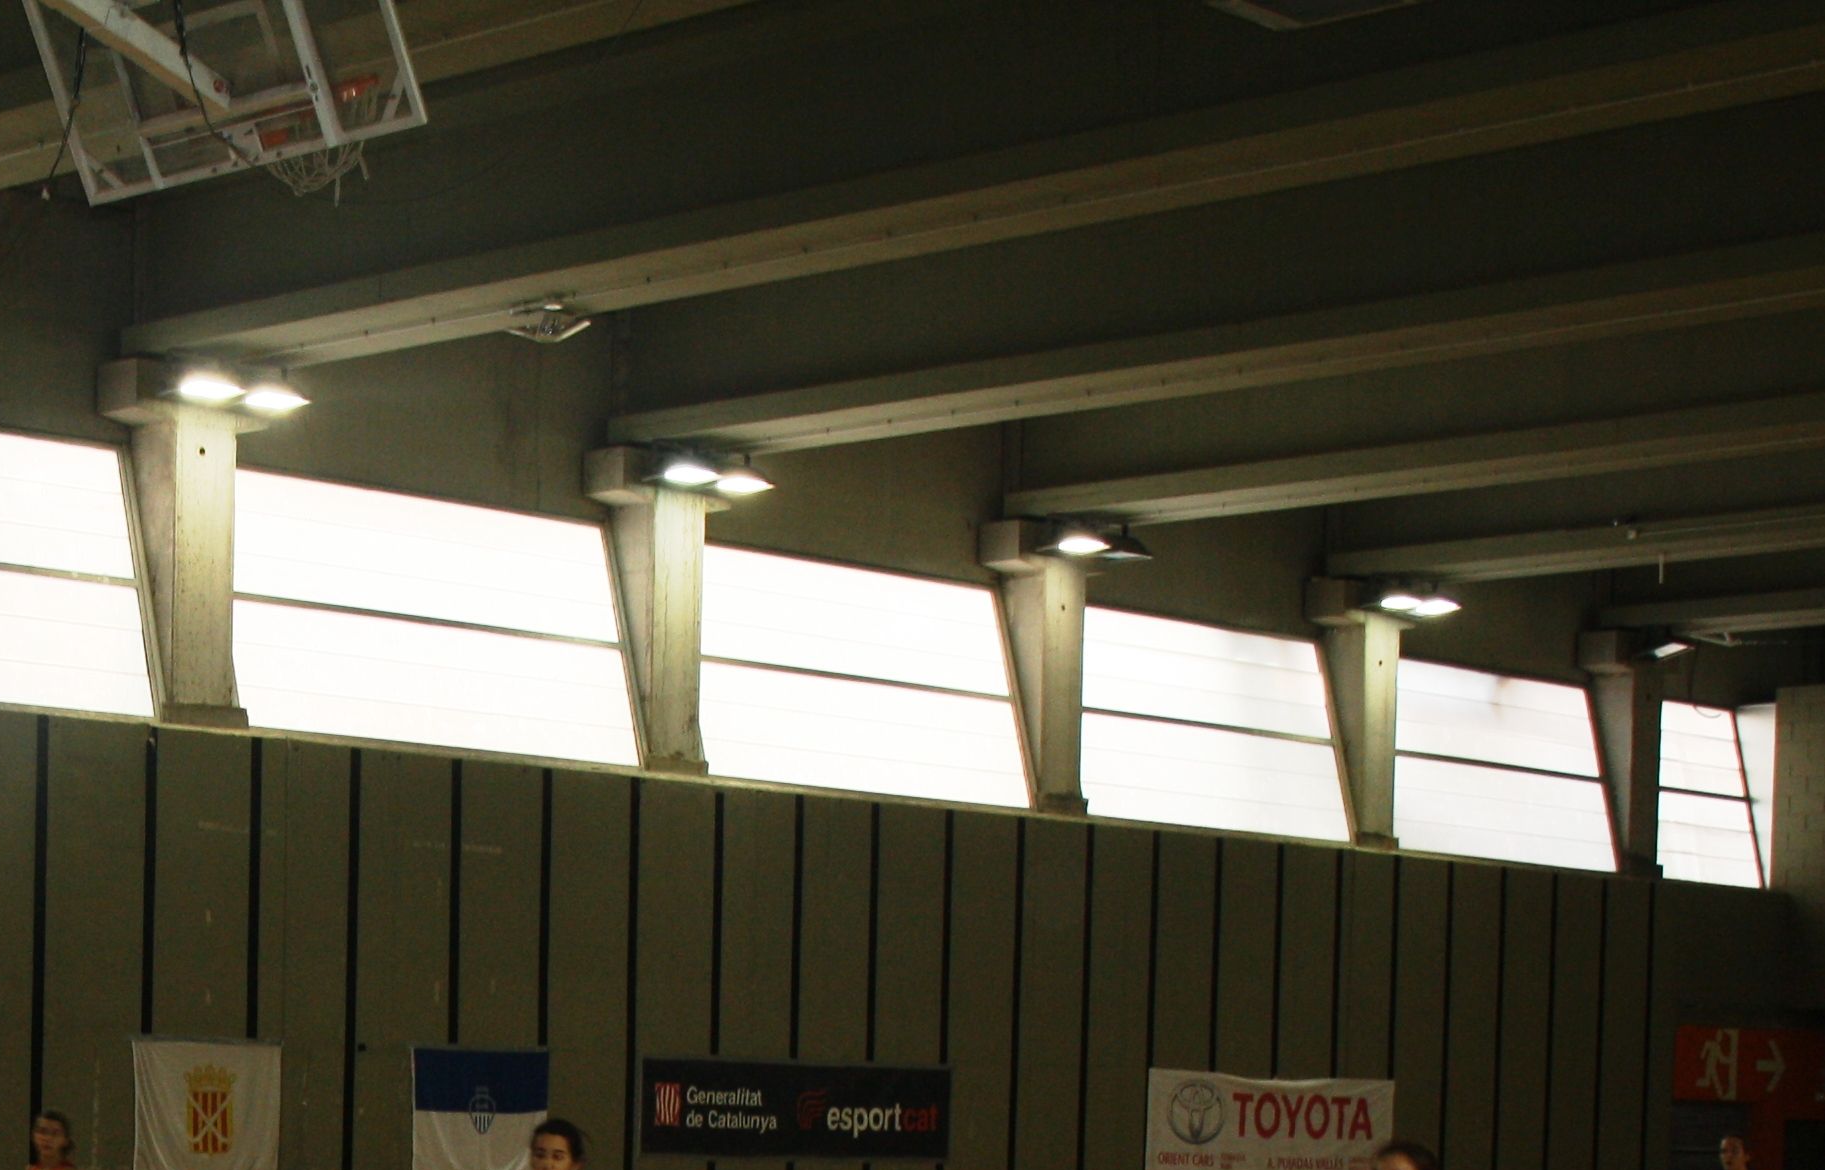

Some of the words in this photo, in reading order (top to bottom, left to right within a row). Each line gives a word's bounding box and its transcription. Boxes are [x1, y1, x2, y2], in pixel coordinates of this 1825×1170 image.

[686, 1085, 763, 1107] Generalitat
[686, 1108, 703, 1127] de
[708, 1110, 777, 1134] Catalunya
[827, 1103, 938, 1139] esportcat
[1232, 1092, 1373, 1141] TOYOTA
